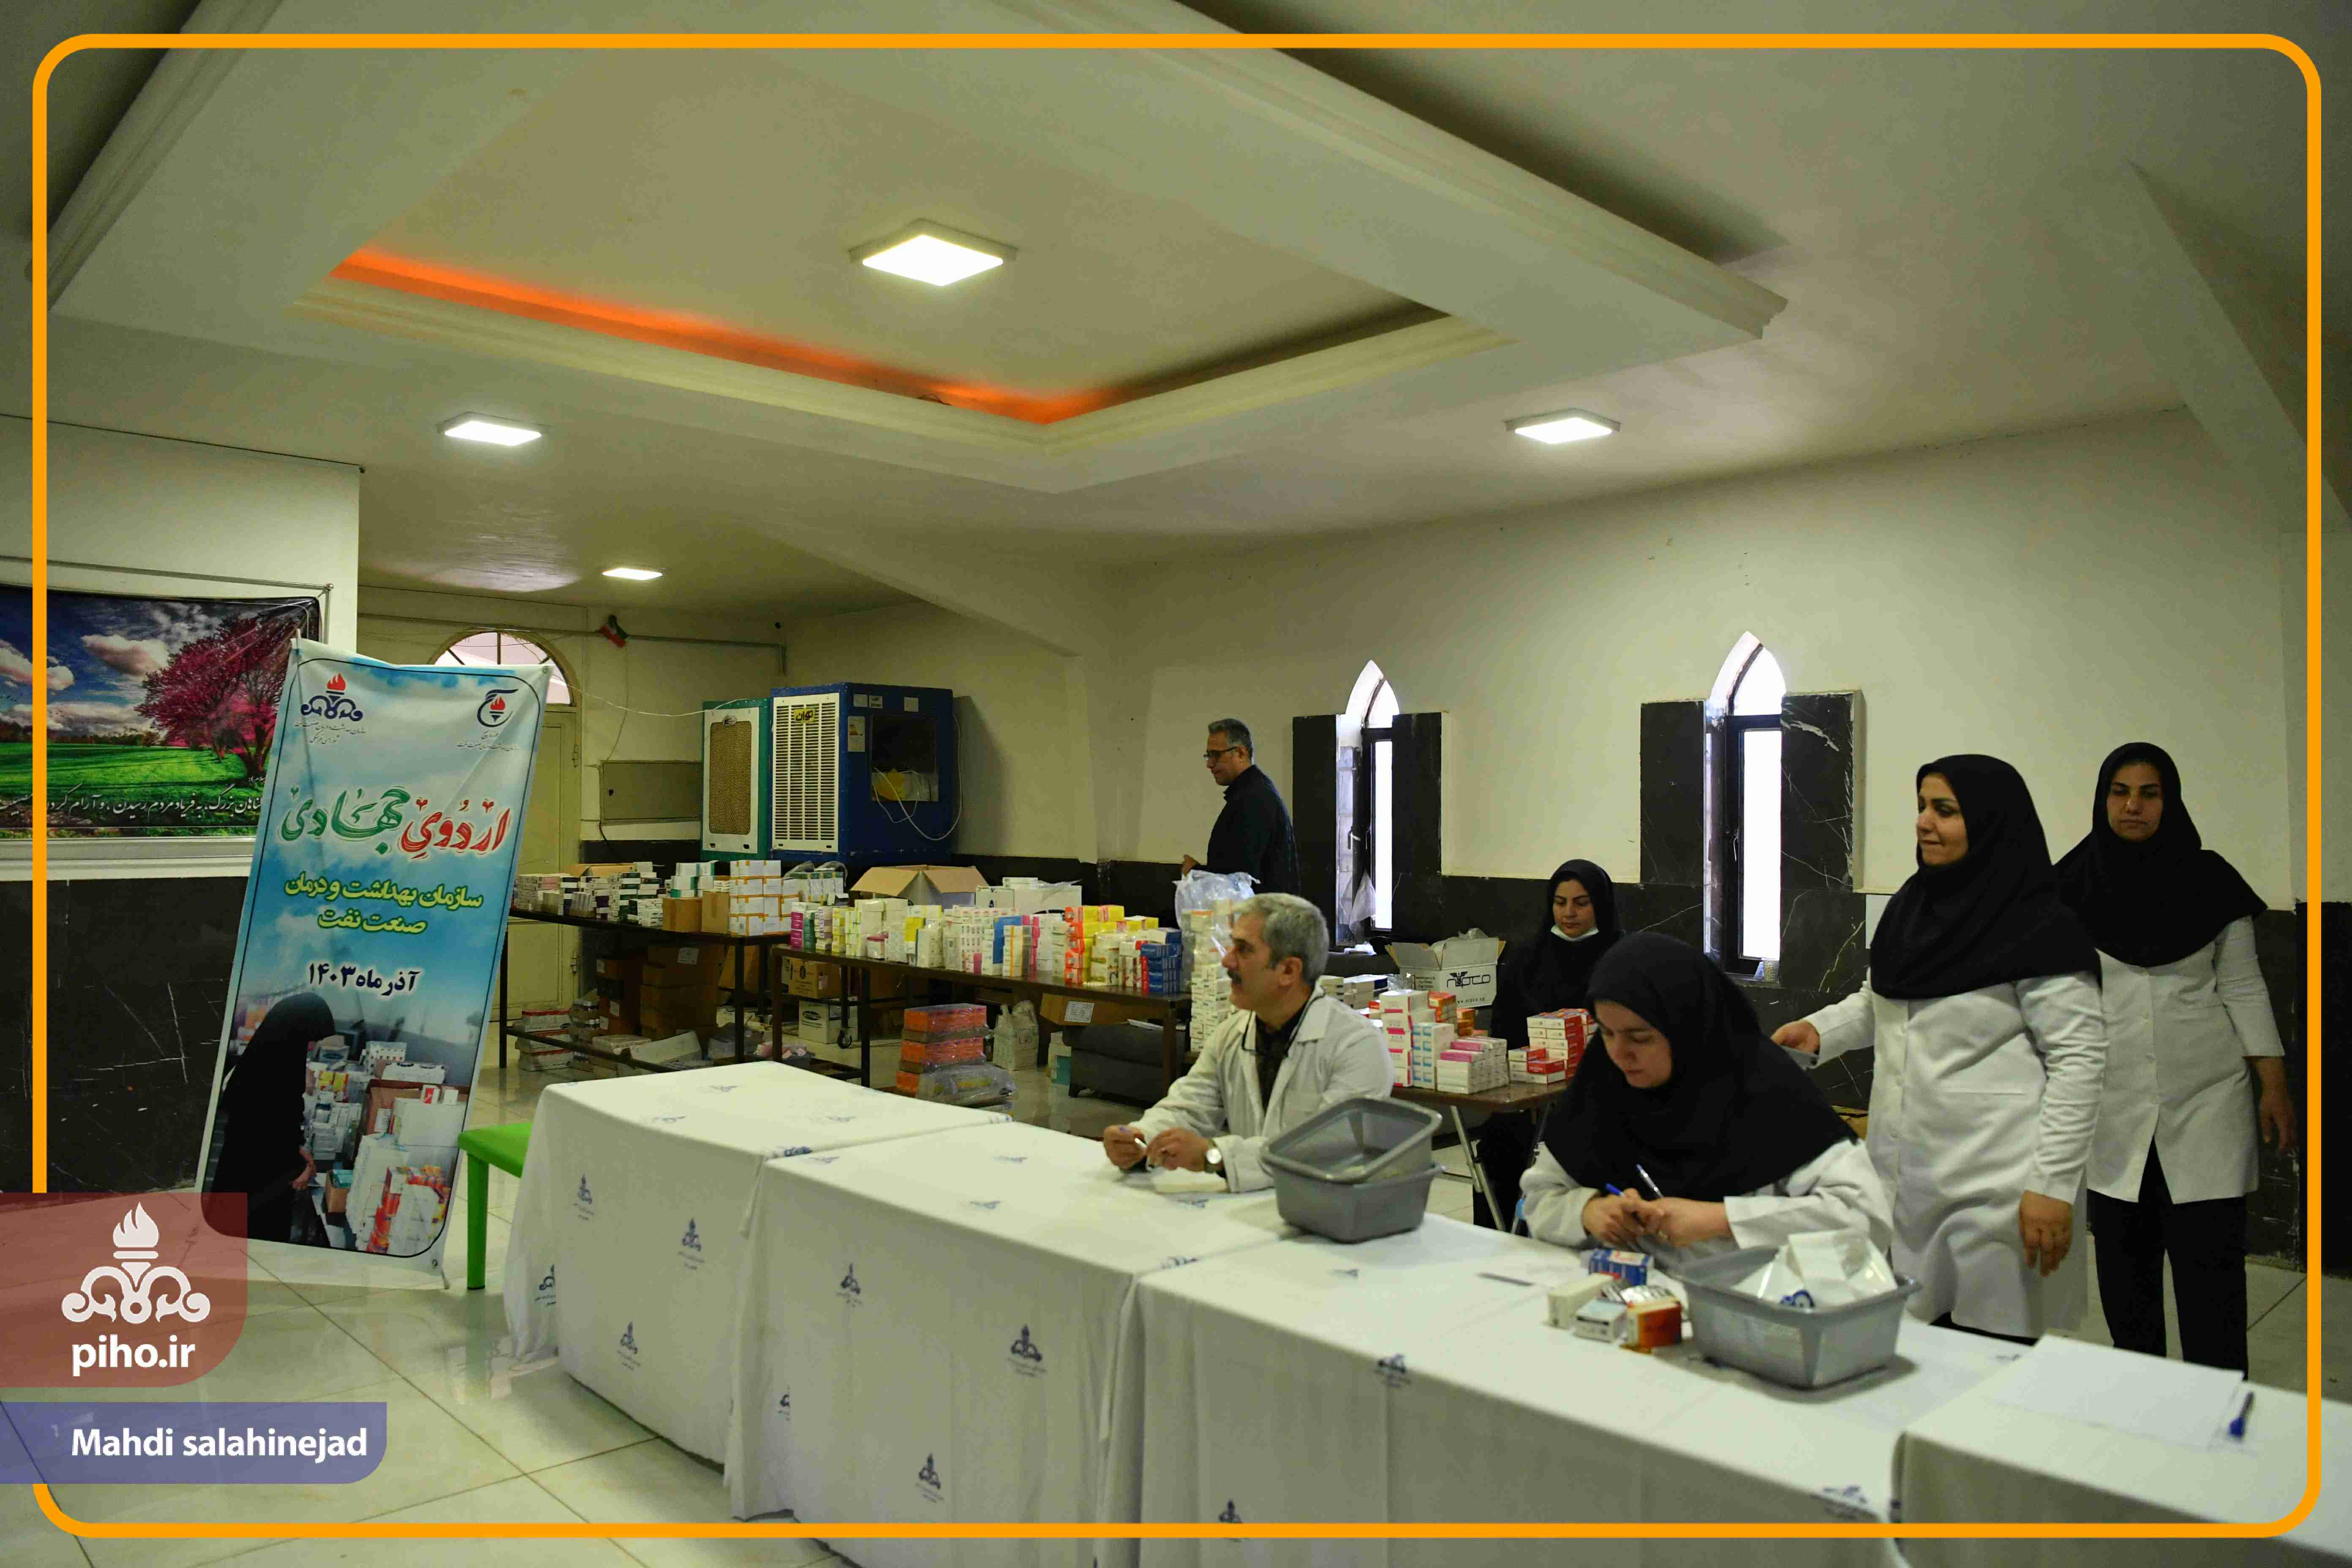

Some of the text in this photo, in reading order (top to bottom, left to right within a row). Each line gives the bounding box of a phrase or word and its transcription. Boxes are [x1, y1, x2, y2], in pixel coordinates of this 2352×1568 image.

[47, 782, 84, 811] کرد
[68, 794, 102, 818] آرام
[175, 792, 196, 817] فریاد
[235, 796, 262, 814] ناهان
[147, 801, 174, 822] مردم
[196, 803, 203, 818] به
[285, 871, 483, 910] سازمان بهداشت و درمان
[318, 907, 428, 935] صنعت نفت
[309, 963, 420, 996] آذر ماه ۱۴۰۳
